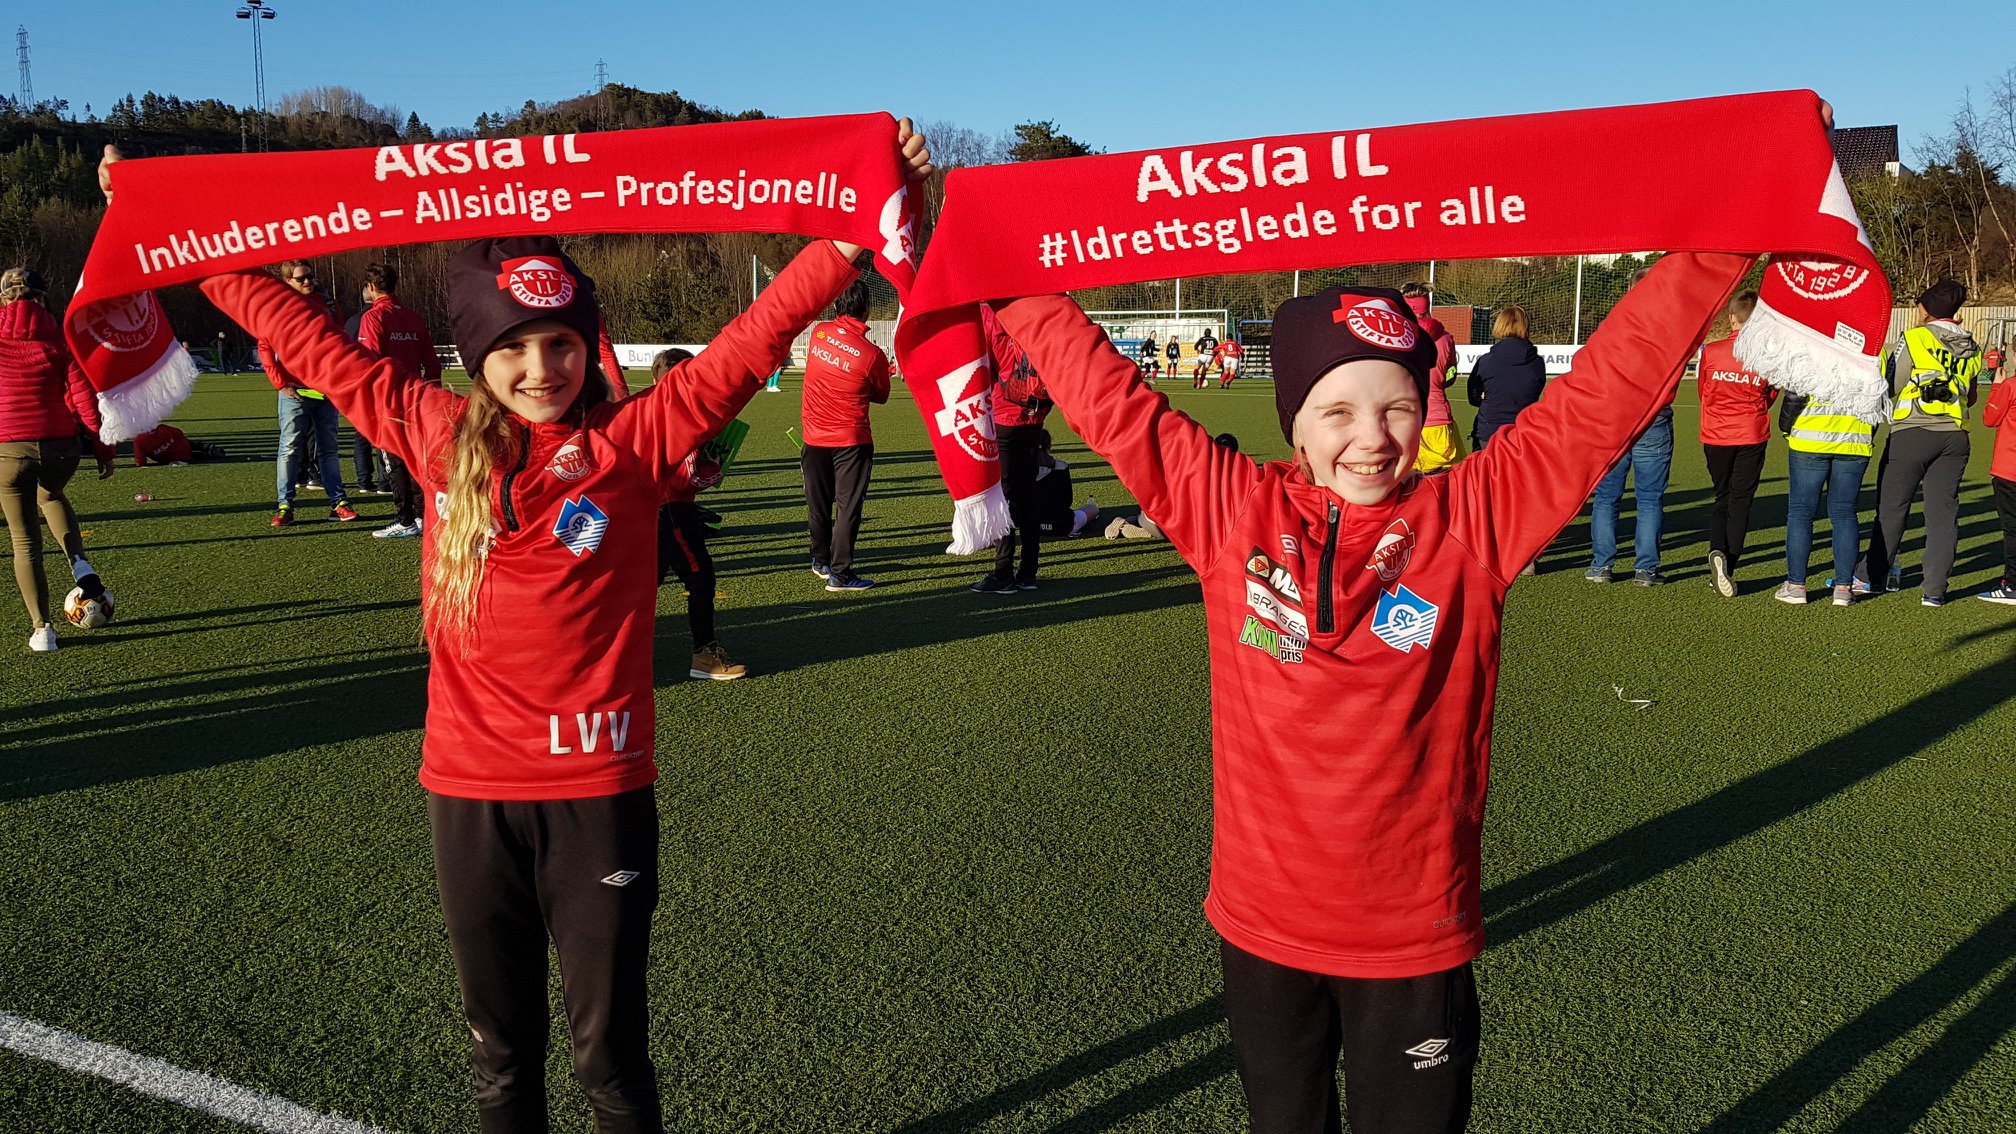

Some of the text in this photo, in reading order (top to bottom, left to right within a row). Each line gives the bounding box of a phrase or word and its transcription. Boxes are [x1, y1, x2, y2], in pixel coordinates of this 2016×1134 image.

[375, 134, 592, 181] Aksla IL
[1136, 133, 1389, 203] Aksla IL
[134, 201, 373, 275] Inkluderende
[415, 182, 572, 223] Allsidige
[615, 169, 857, 213] Profesjonelle
[1038, 185, 1526, 268] #Idrettsglede for alle
[509, 270, 571, 285] AKSLA
[1809, 265, 1857, 292] 1928
[513, 284, 571, 306] STIFTA 1928
[1346, 308, 1413, 332] AKSLA
[1205, 340, 1214, 349] 10
[1351, 319, 1394, 346] STIFTA
[825, 335, 861, 357] TAFJORD
[1227, 344, 1234, 352] 8
[811, 345, 851, 374] AKSLA IL
[1711, 370, 1762, 387] AKSLA IL
[953, 392, 993, 428] AKS
[553, 451, 580, 466] AKSL
[1374, 541, 1408, 562] AKSLA
[1253, 592, 1307, 637] BRAGES
[1280, 648, 1302, 662] pris
[549, 711, 630, 755] LVV
[1413, 1054, 1449, 1070] umbro
